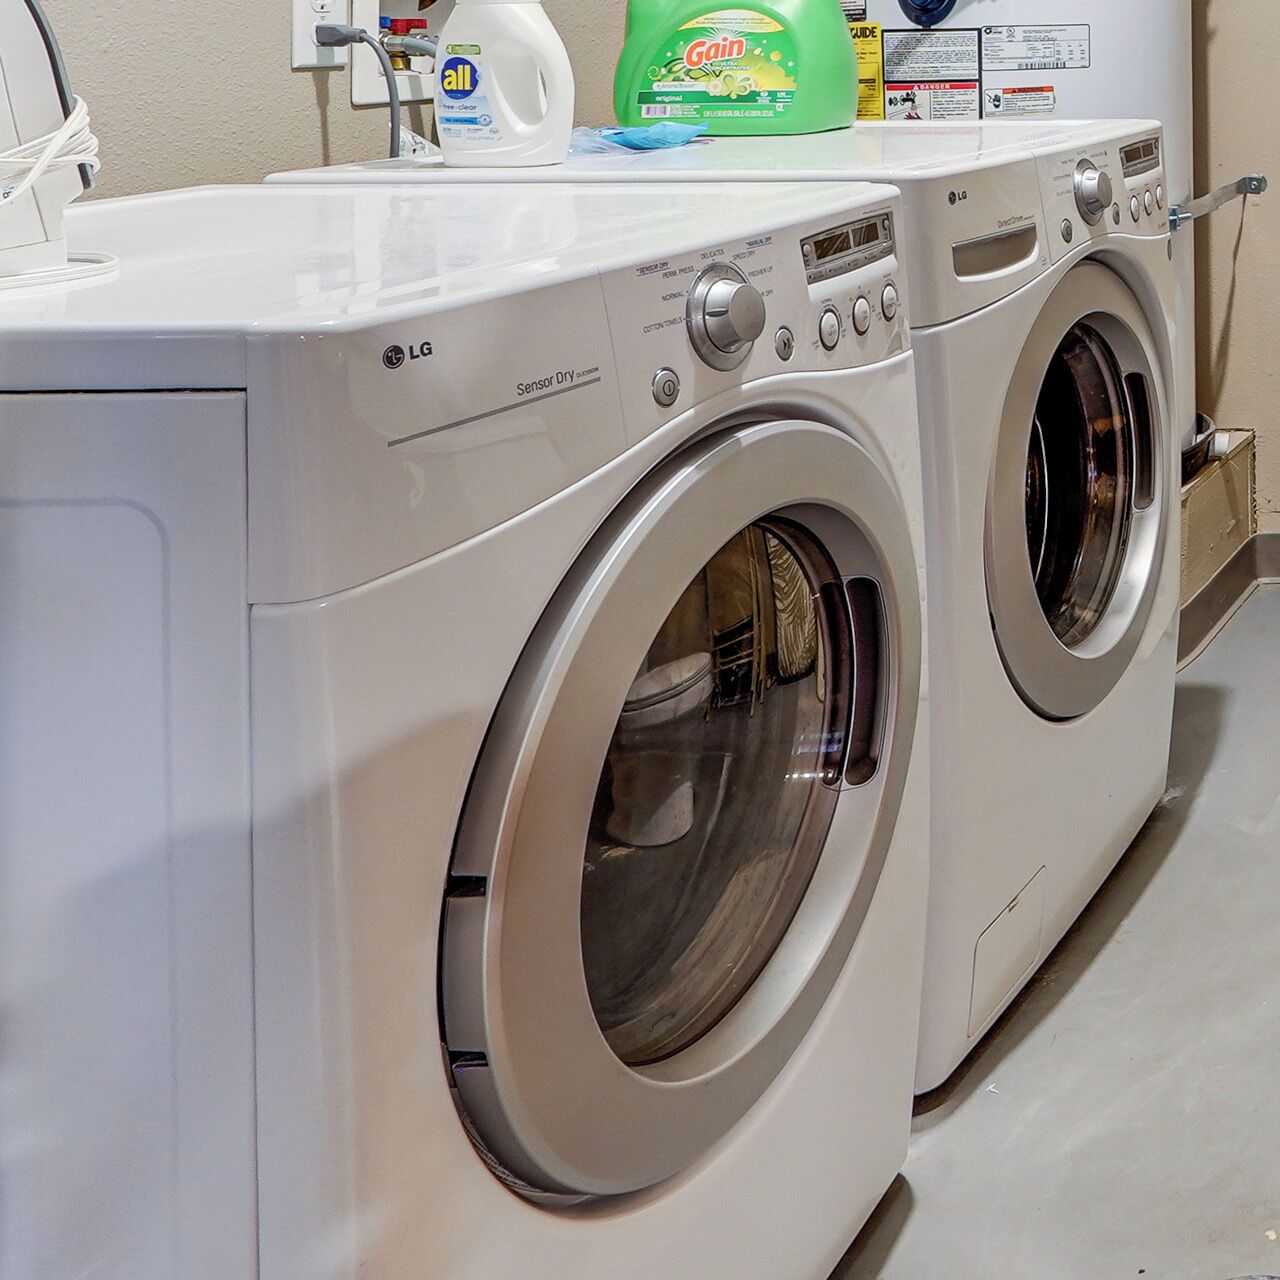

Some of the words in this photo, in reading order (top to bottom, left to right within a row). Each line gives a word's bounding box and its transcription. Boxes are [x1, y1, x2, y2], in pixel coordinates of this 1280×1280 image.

[850, 26, 877, 39] GUIDE
[685, 36, 745, 68] Gain
[443, 64, 471, 90] all
[457, 103, 478, 111] clear
[655, 95, 683, 103] original
[957, 190, 968, 201] LG
[408, 341, 433, 360] LG
[516, 375, 555, 396] Sensor
[555, 369, 575, 384] Dry
